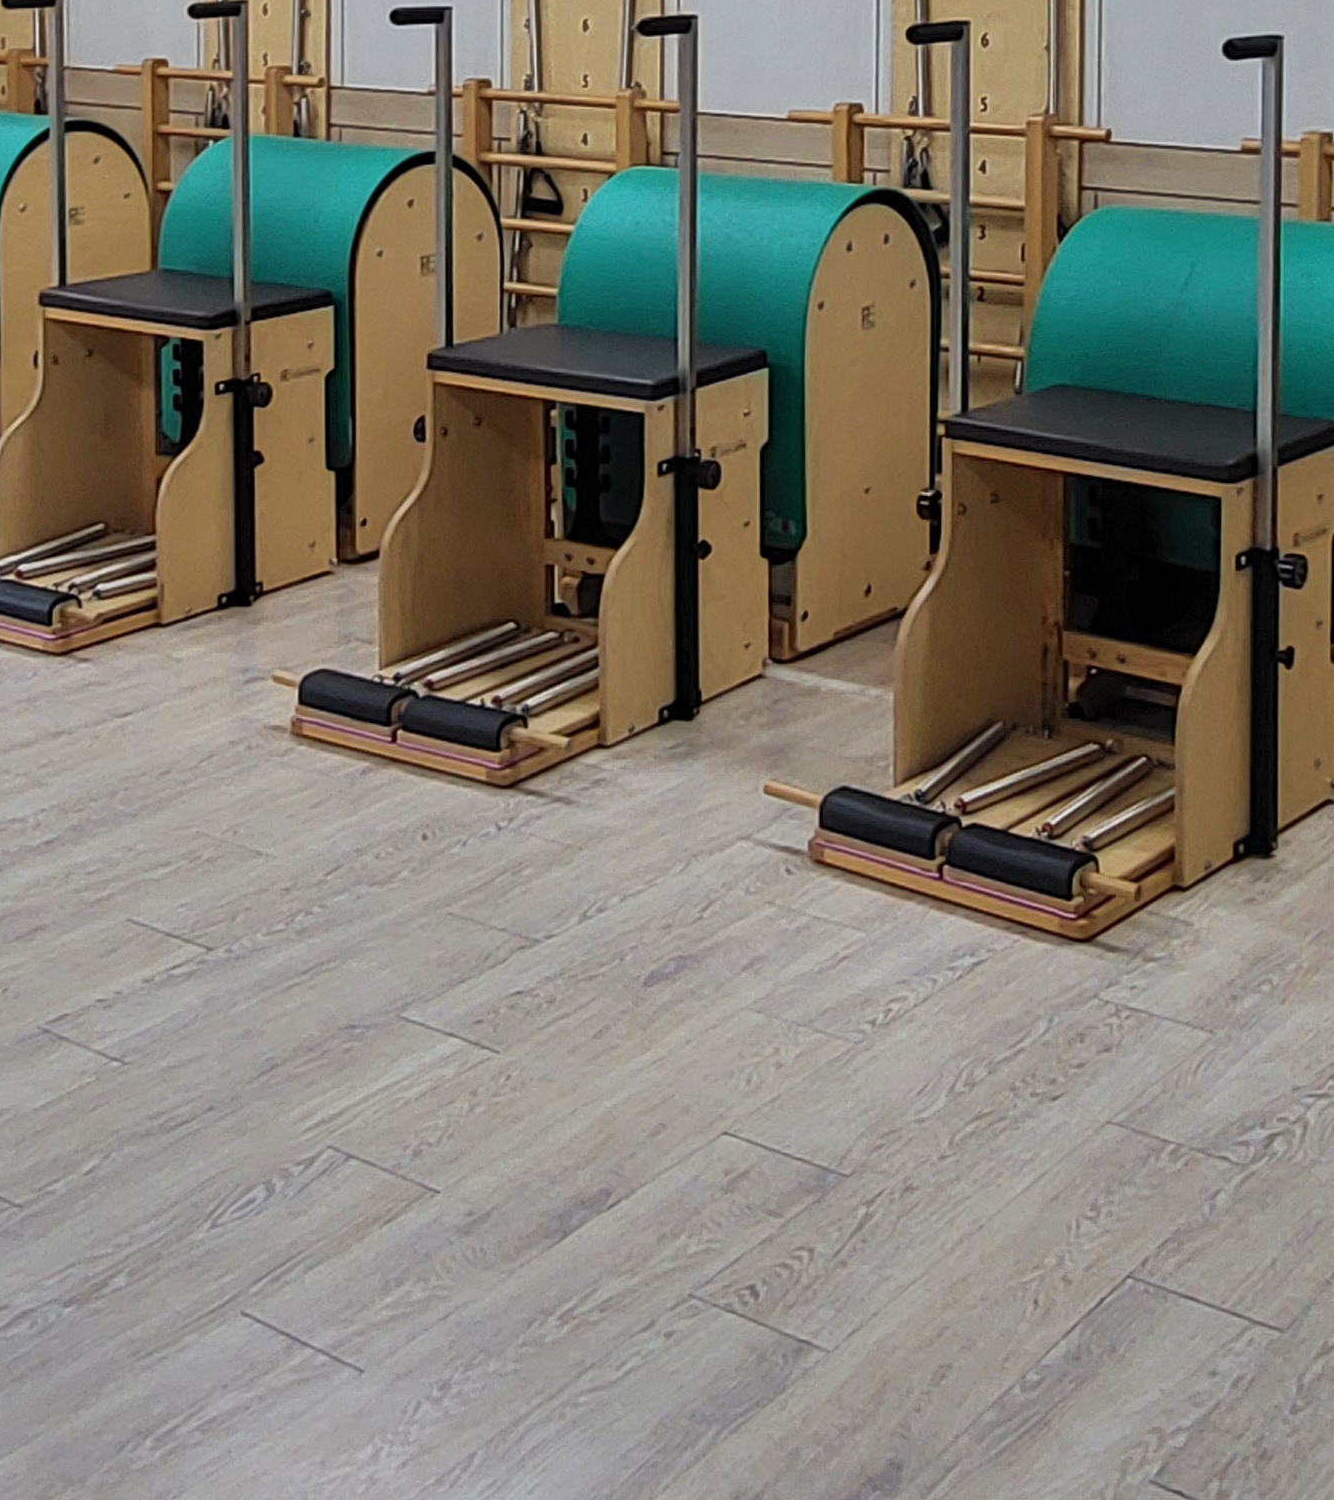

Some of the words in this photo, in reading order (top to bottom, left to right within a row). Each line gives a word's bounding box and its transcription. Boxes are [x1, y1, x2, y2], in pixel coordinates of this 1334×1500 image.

[980, 31, 990, 49] 6
[979, 96, 988, 113] 5
[977, 159, 987, 175] 4
[977, 223, 987, 241] 3
[975, 286, 987, 303] 2
